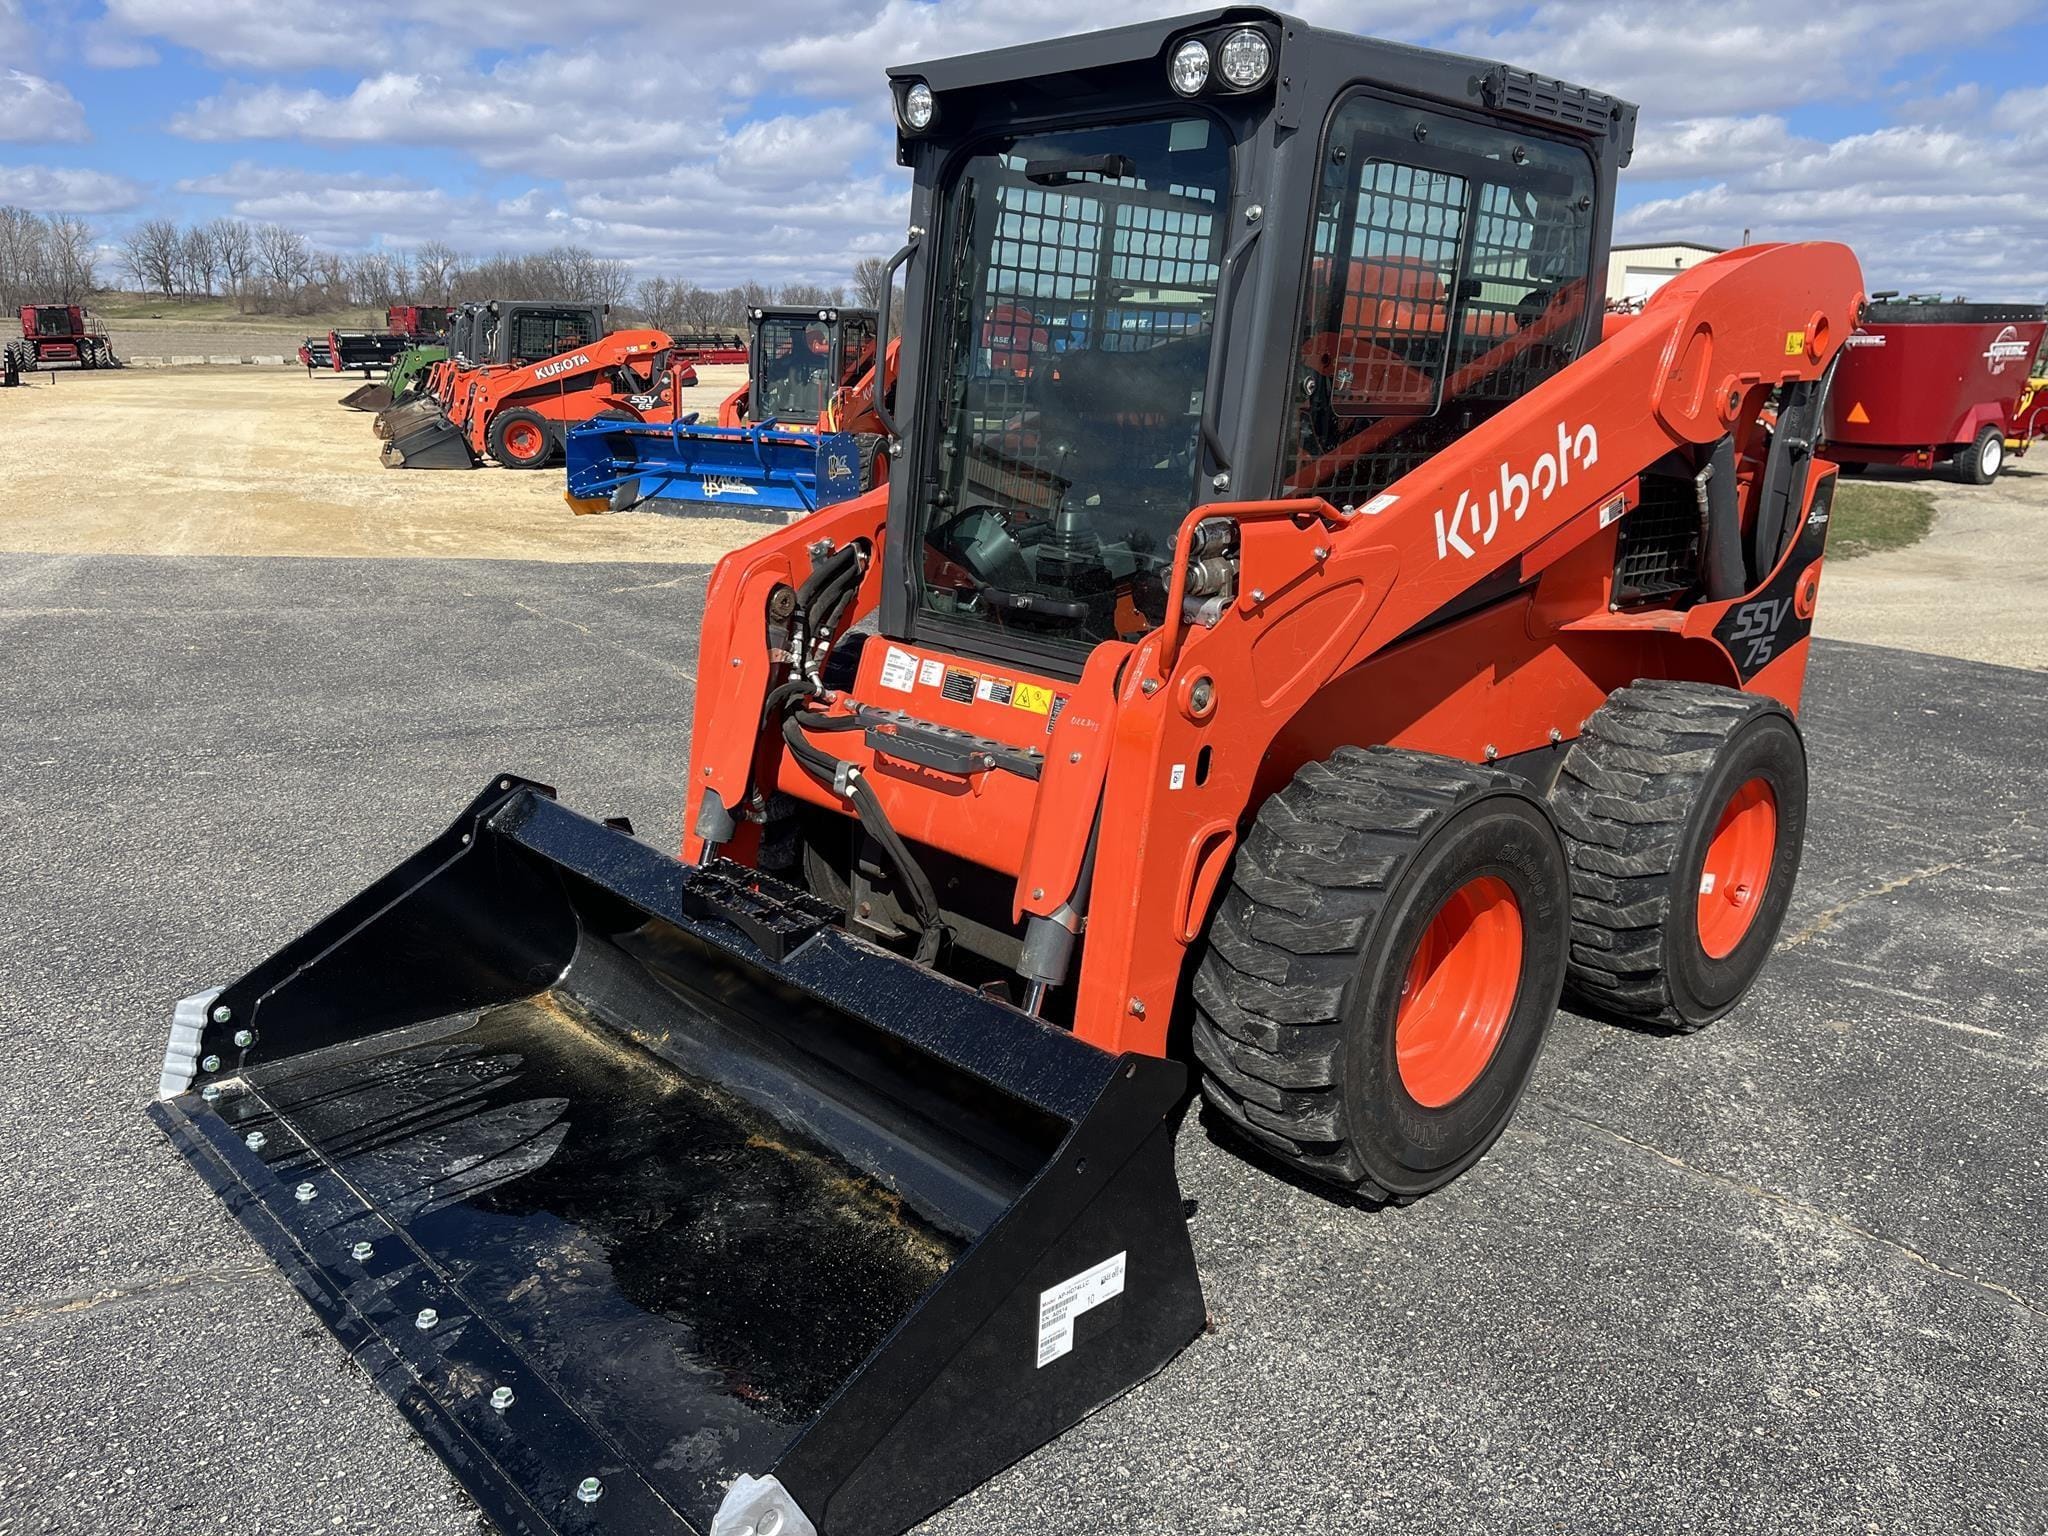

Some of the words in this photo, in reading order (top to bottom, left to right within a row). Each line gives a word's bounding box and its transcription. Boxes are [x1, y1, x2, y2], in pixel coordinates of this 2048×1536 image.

[534, 353, 590, 380] KUBOTA
[630, 395, 658, 404] SSV
[1434, 421, 1598, 560] Kubota
[1730, 597, 1792, 641] SSV
[1743, 634, 1775, 668] 75
